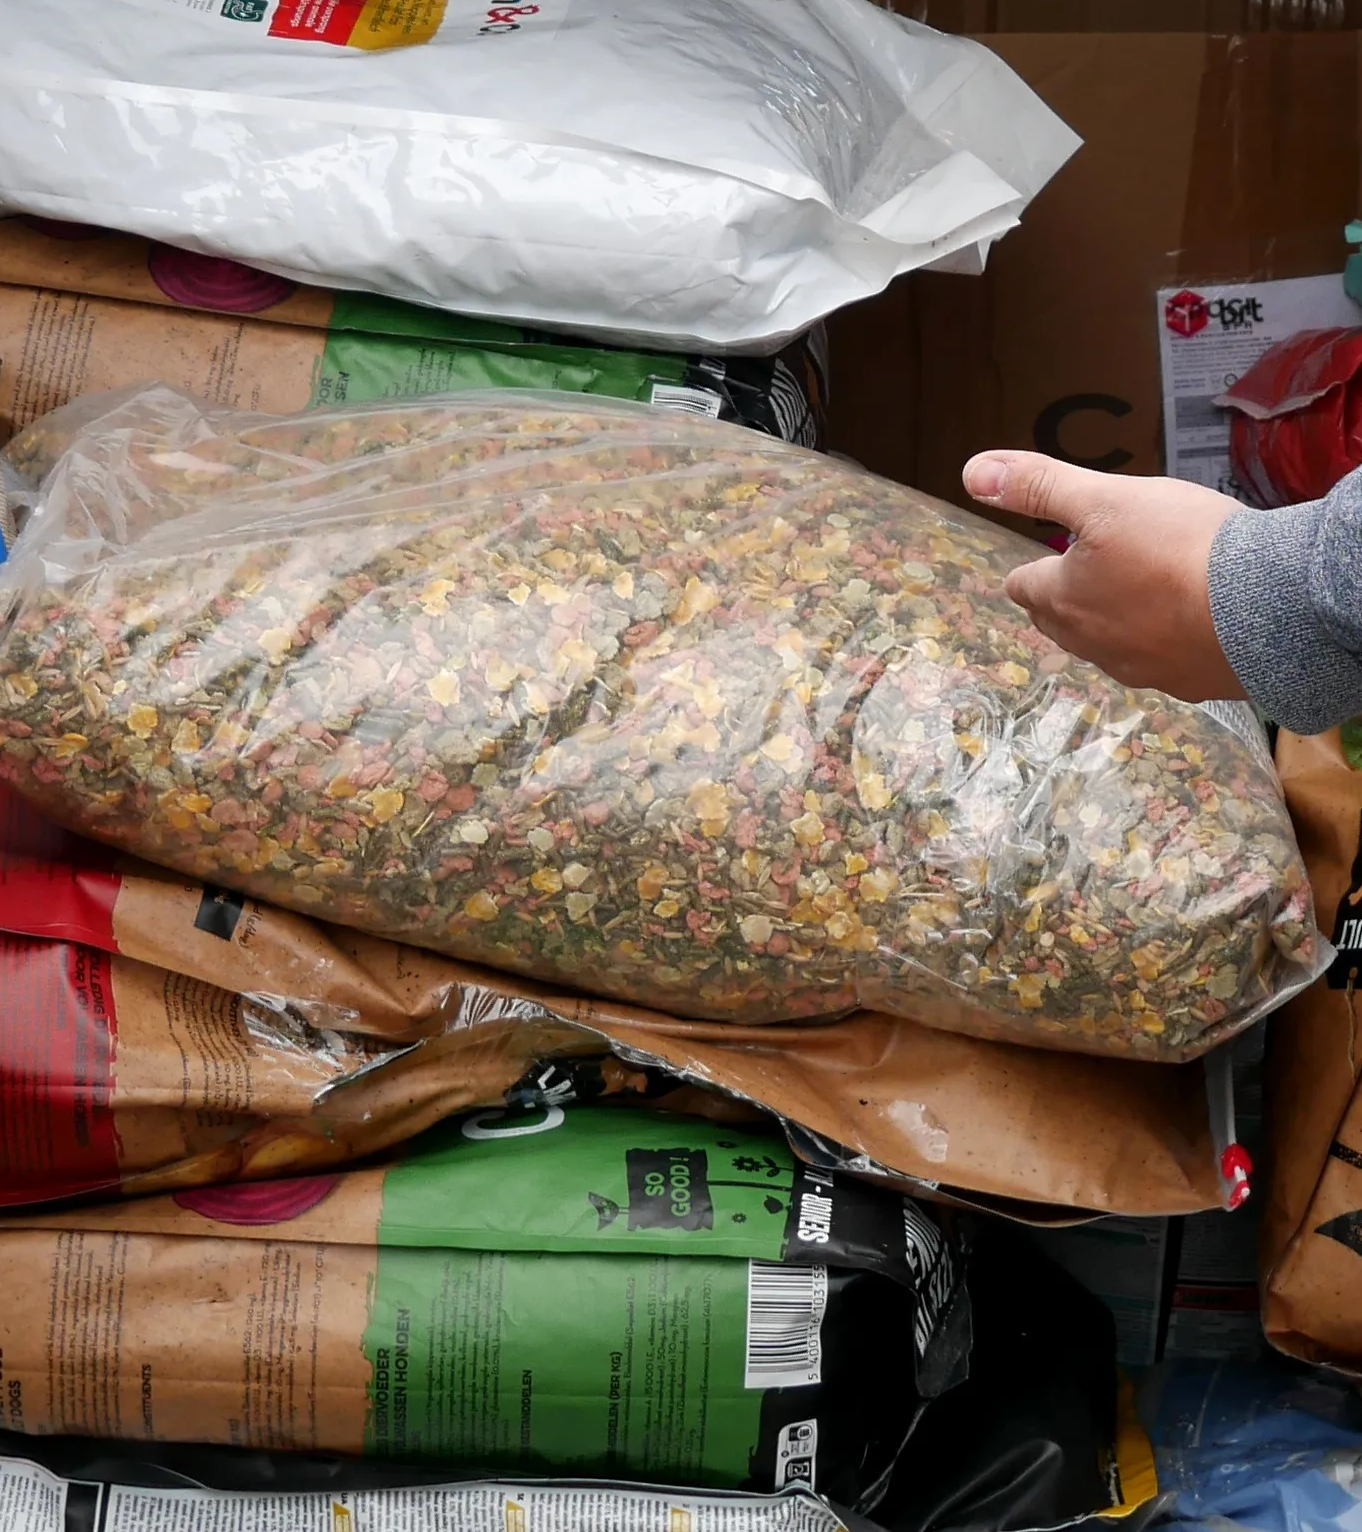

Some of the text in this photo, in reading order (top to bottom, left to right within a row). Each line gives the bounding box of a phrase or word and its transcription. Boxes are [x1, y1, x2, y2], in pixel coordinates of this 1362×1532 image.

[643, 1171, 665, 1196] SO
[796, 1191, 834, 1243] SENIOR
[392, 1307, 411, 1382] HONDEN
[805, 1263, 829, 1380] 5 400116 103155
[8, 1379, 22, 1416] DOGS
[375, 1347, 389, 1436] DIERVOEDER
[607, 1350, 622, 1400] (PER KG)
